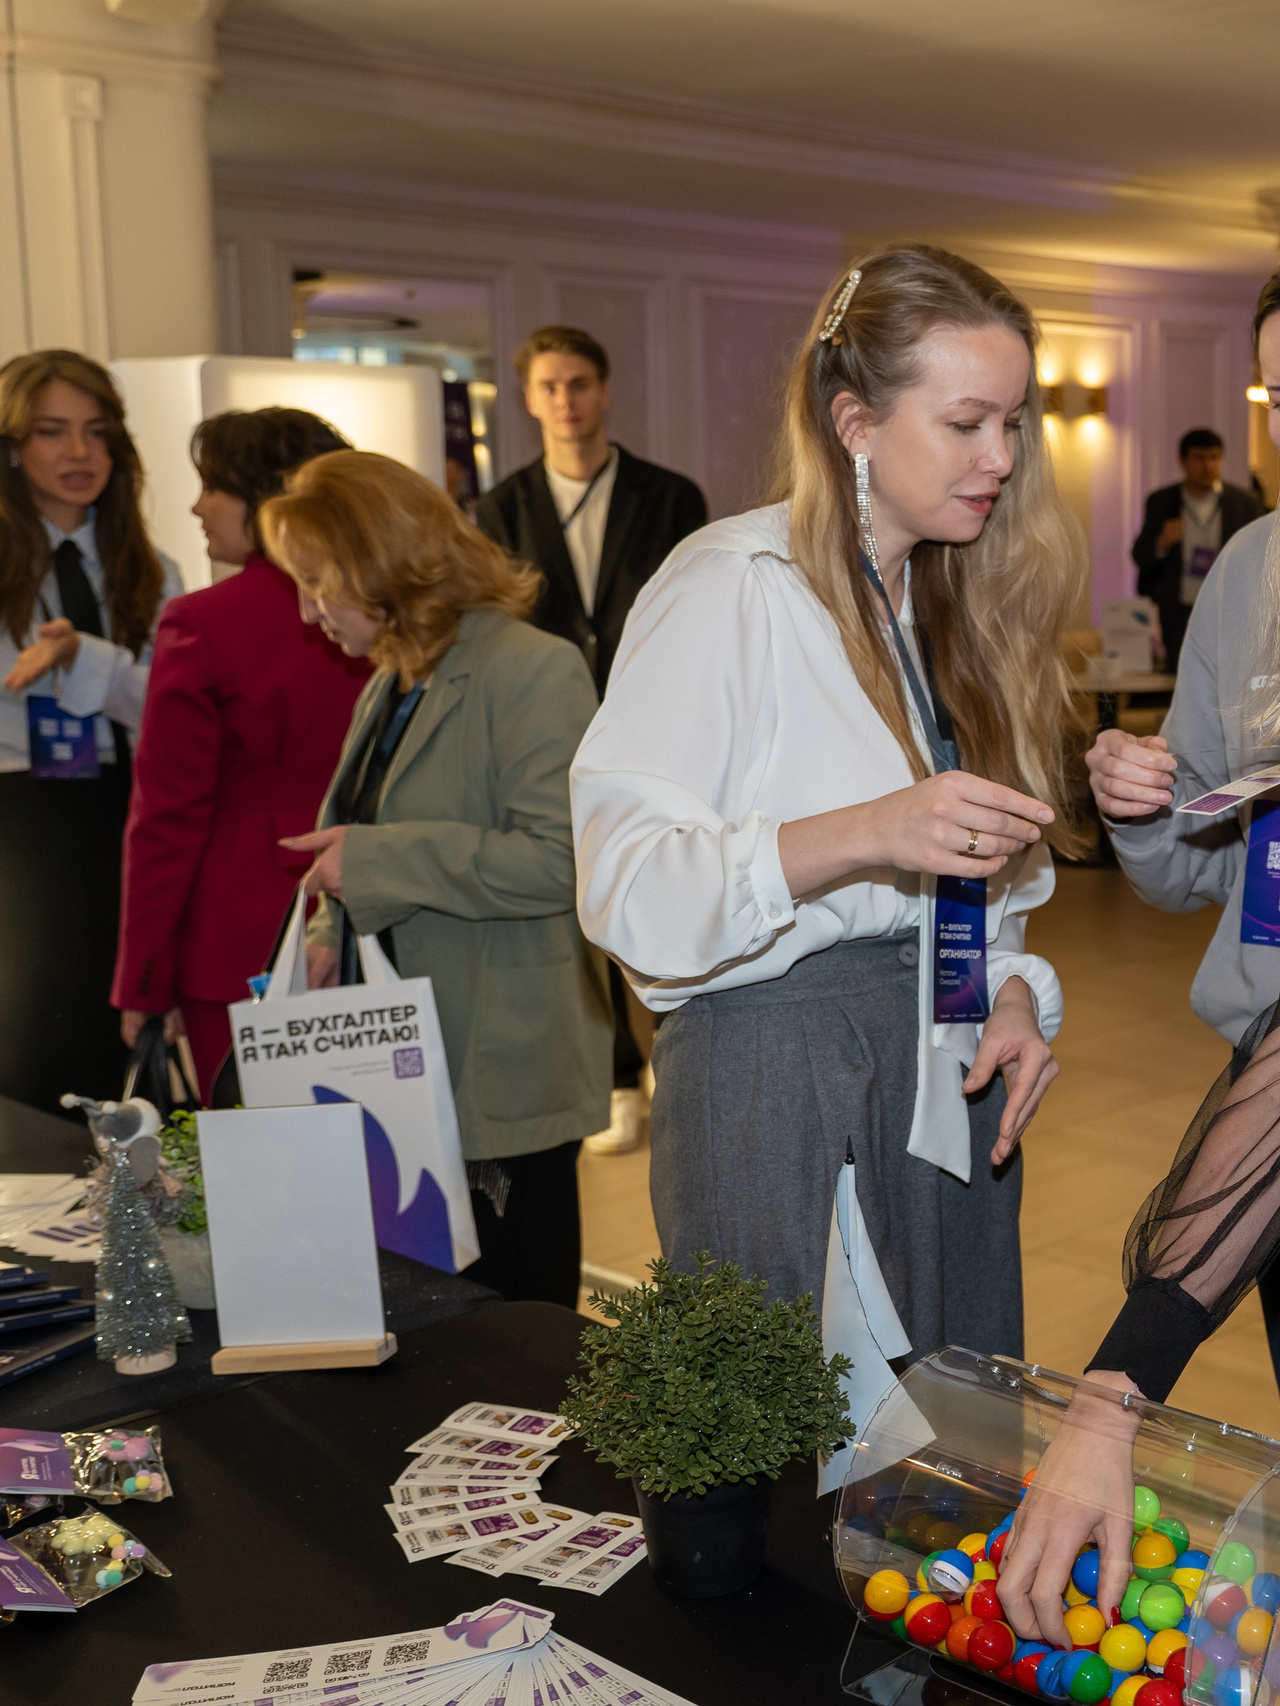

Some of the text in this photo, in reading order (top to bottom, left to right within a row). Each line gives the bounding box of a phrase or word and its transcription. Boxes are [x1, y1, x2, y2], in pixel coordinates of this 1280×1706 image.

[939, 949, 982, 959] ОРГАНИЗАТОР
[240, 1027, 255, 1044] Я
[287, 1004, 417, 1038] БУХГАЛТЕР
[243, 1024, 419, 1063] Я ТАК СЧИТАЮ!
